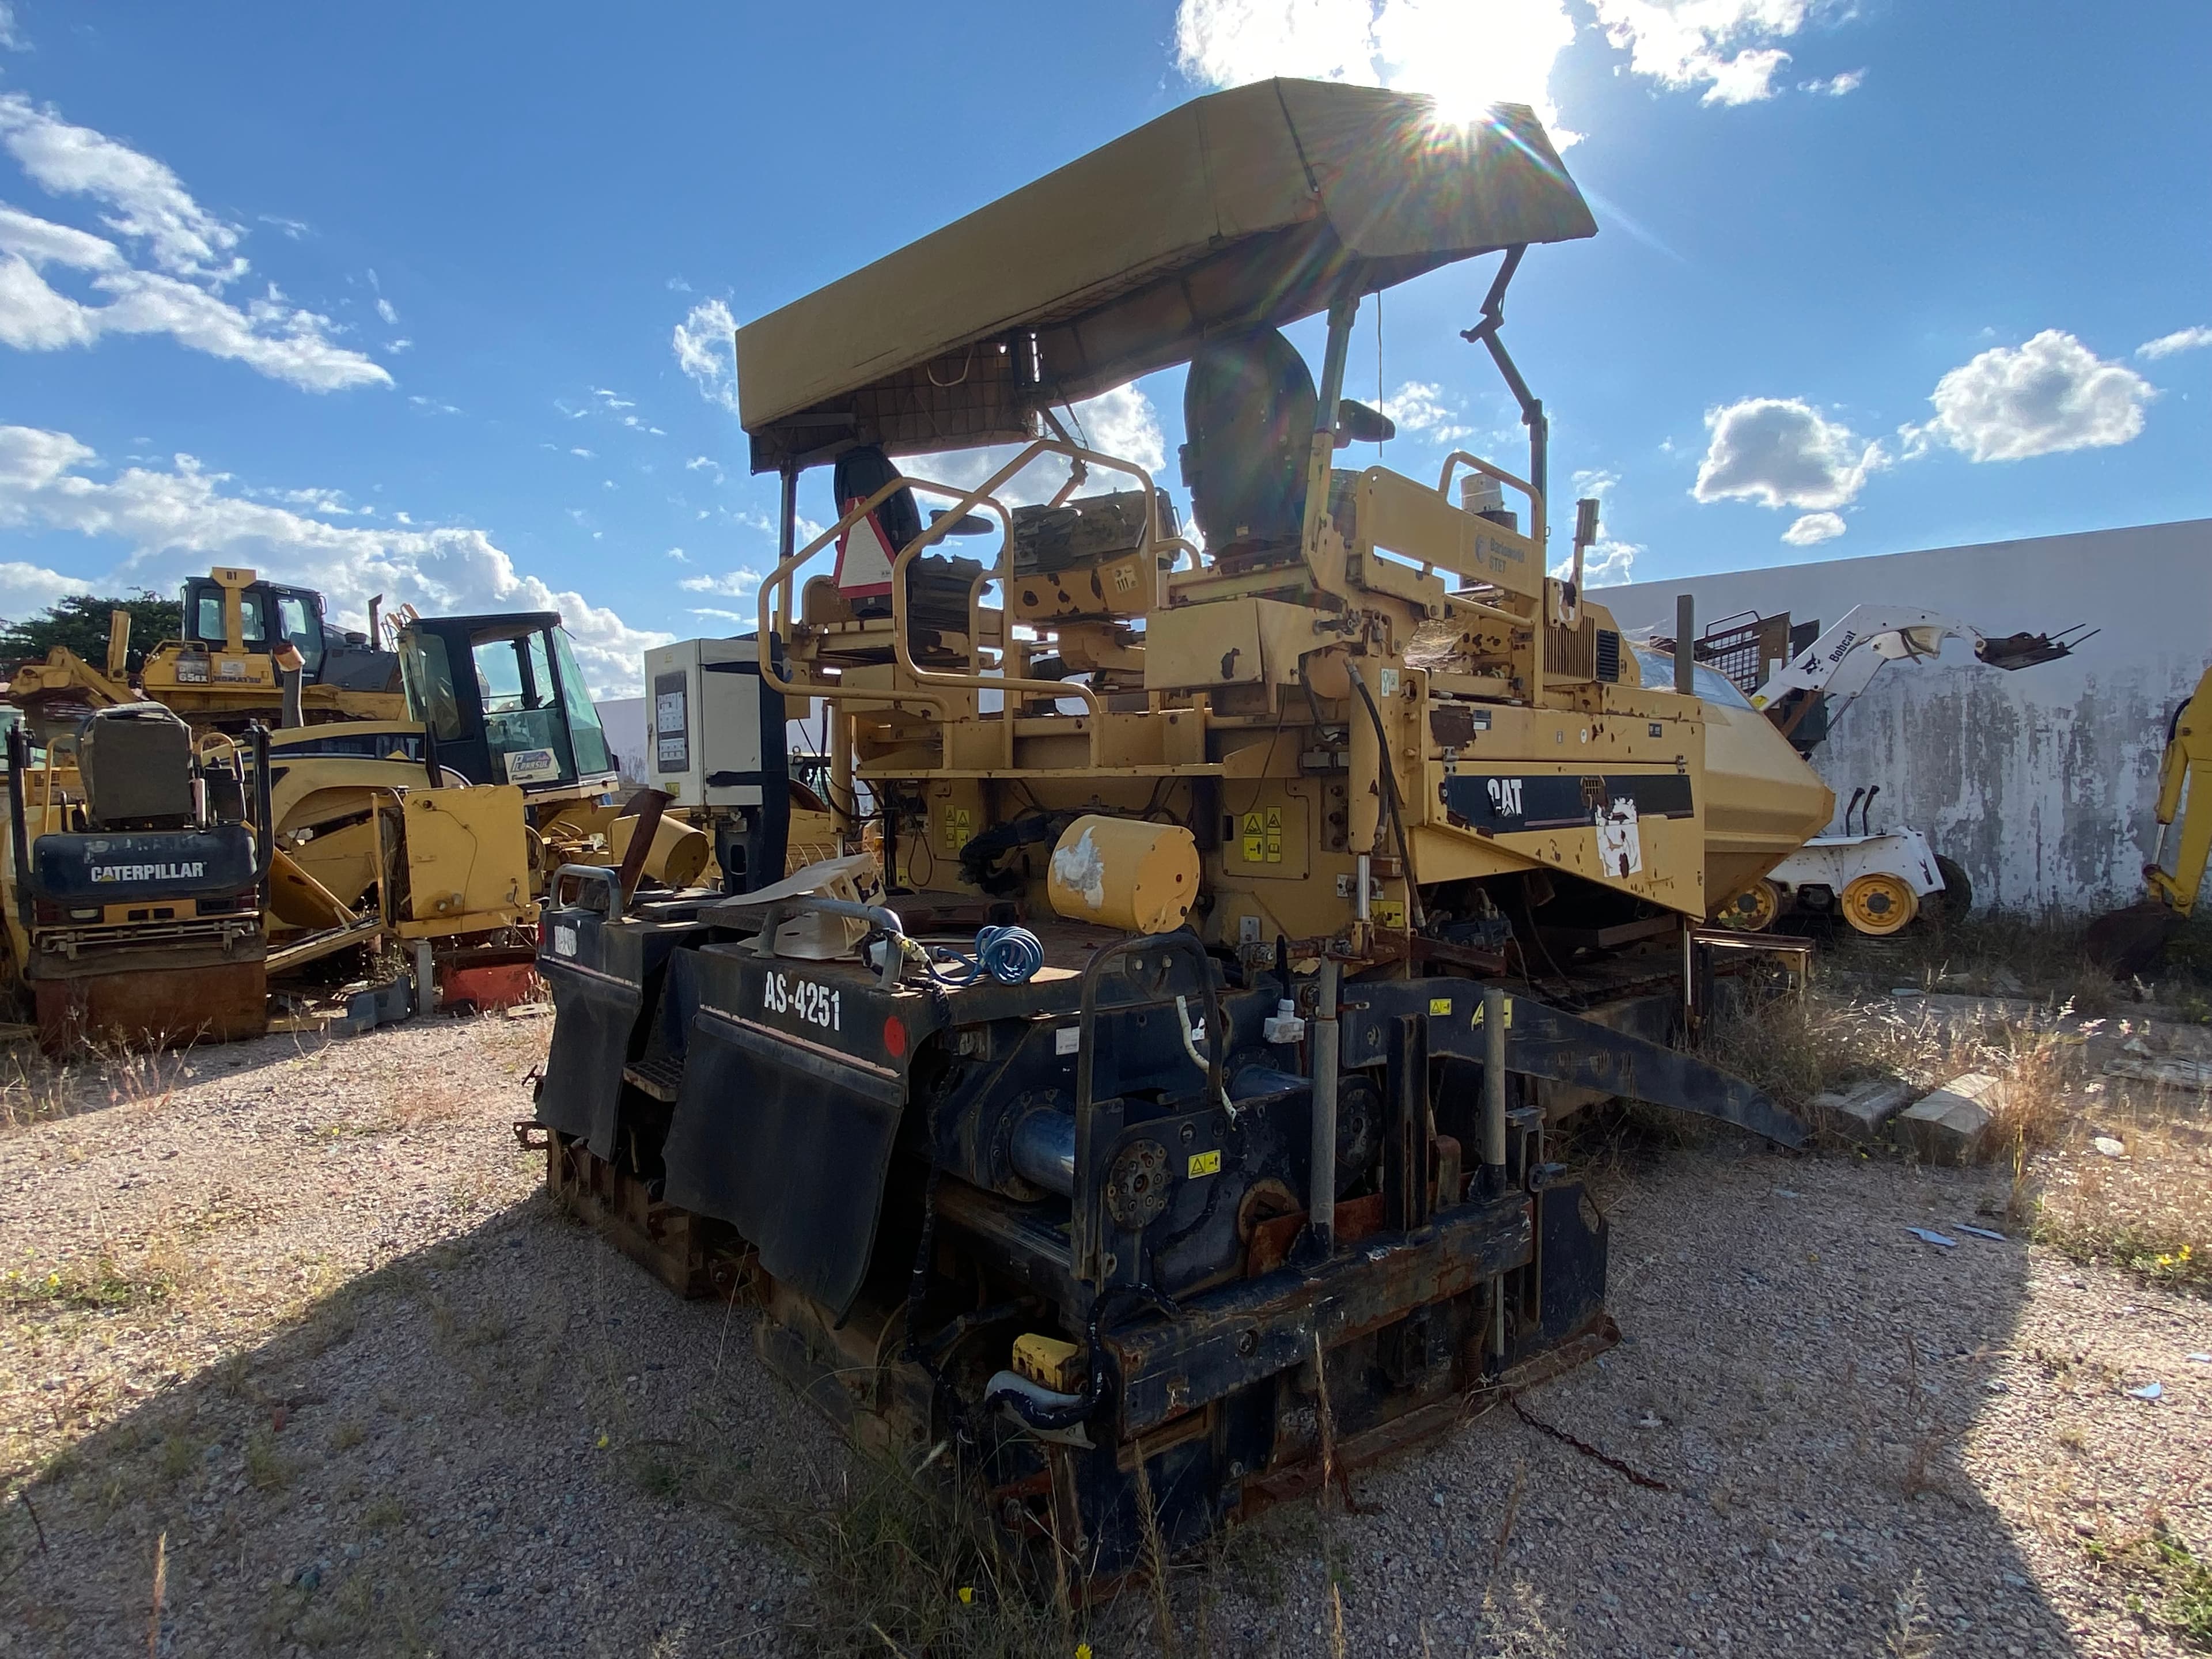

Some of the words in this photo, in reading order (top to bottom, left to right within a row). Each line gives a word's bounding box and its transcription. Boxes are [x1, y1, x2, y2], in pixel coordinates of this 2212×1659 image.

[1829, 630, 1857, 662] Bobcat
[376, 736, 421, 762] CAT
[1487, 778, 1522, 816] CAT
[91, 862, 204, 882] CATERPILLAR
[764, 971, 840, 1031] AS-4251
